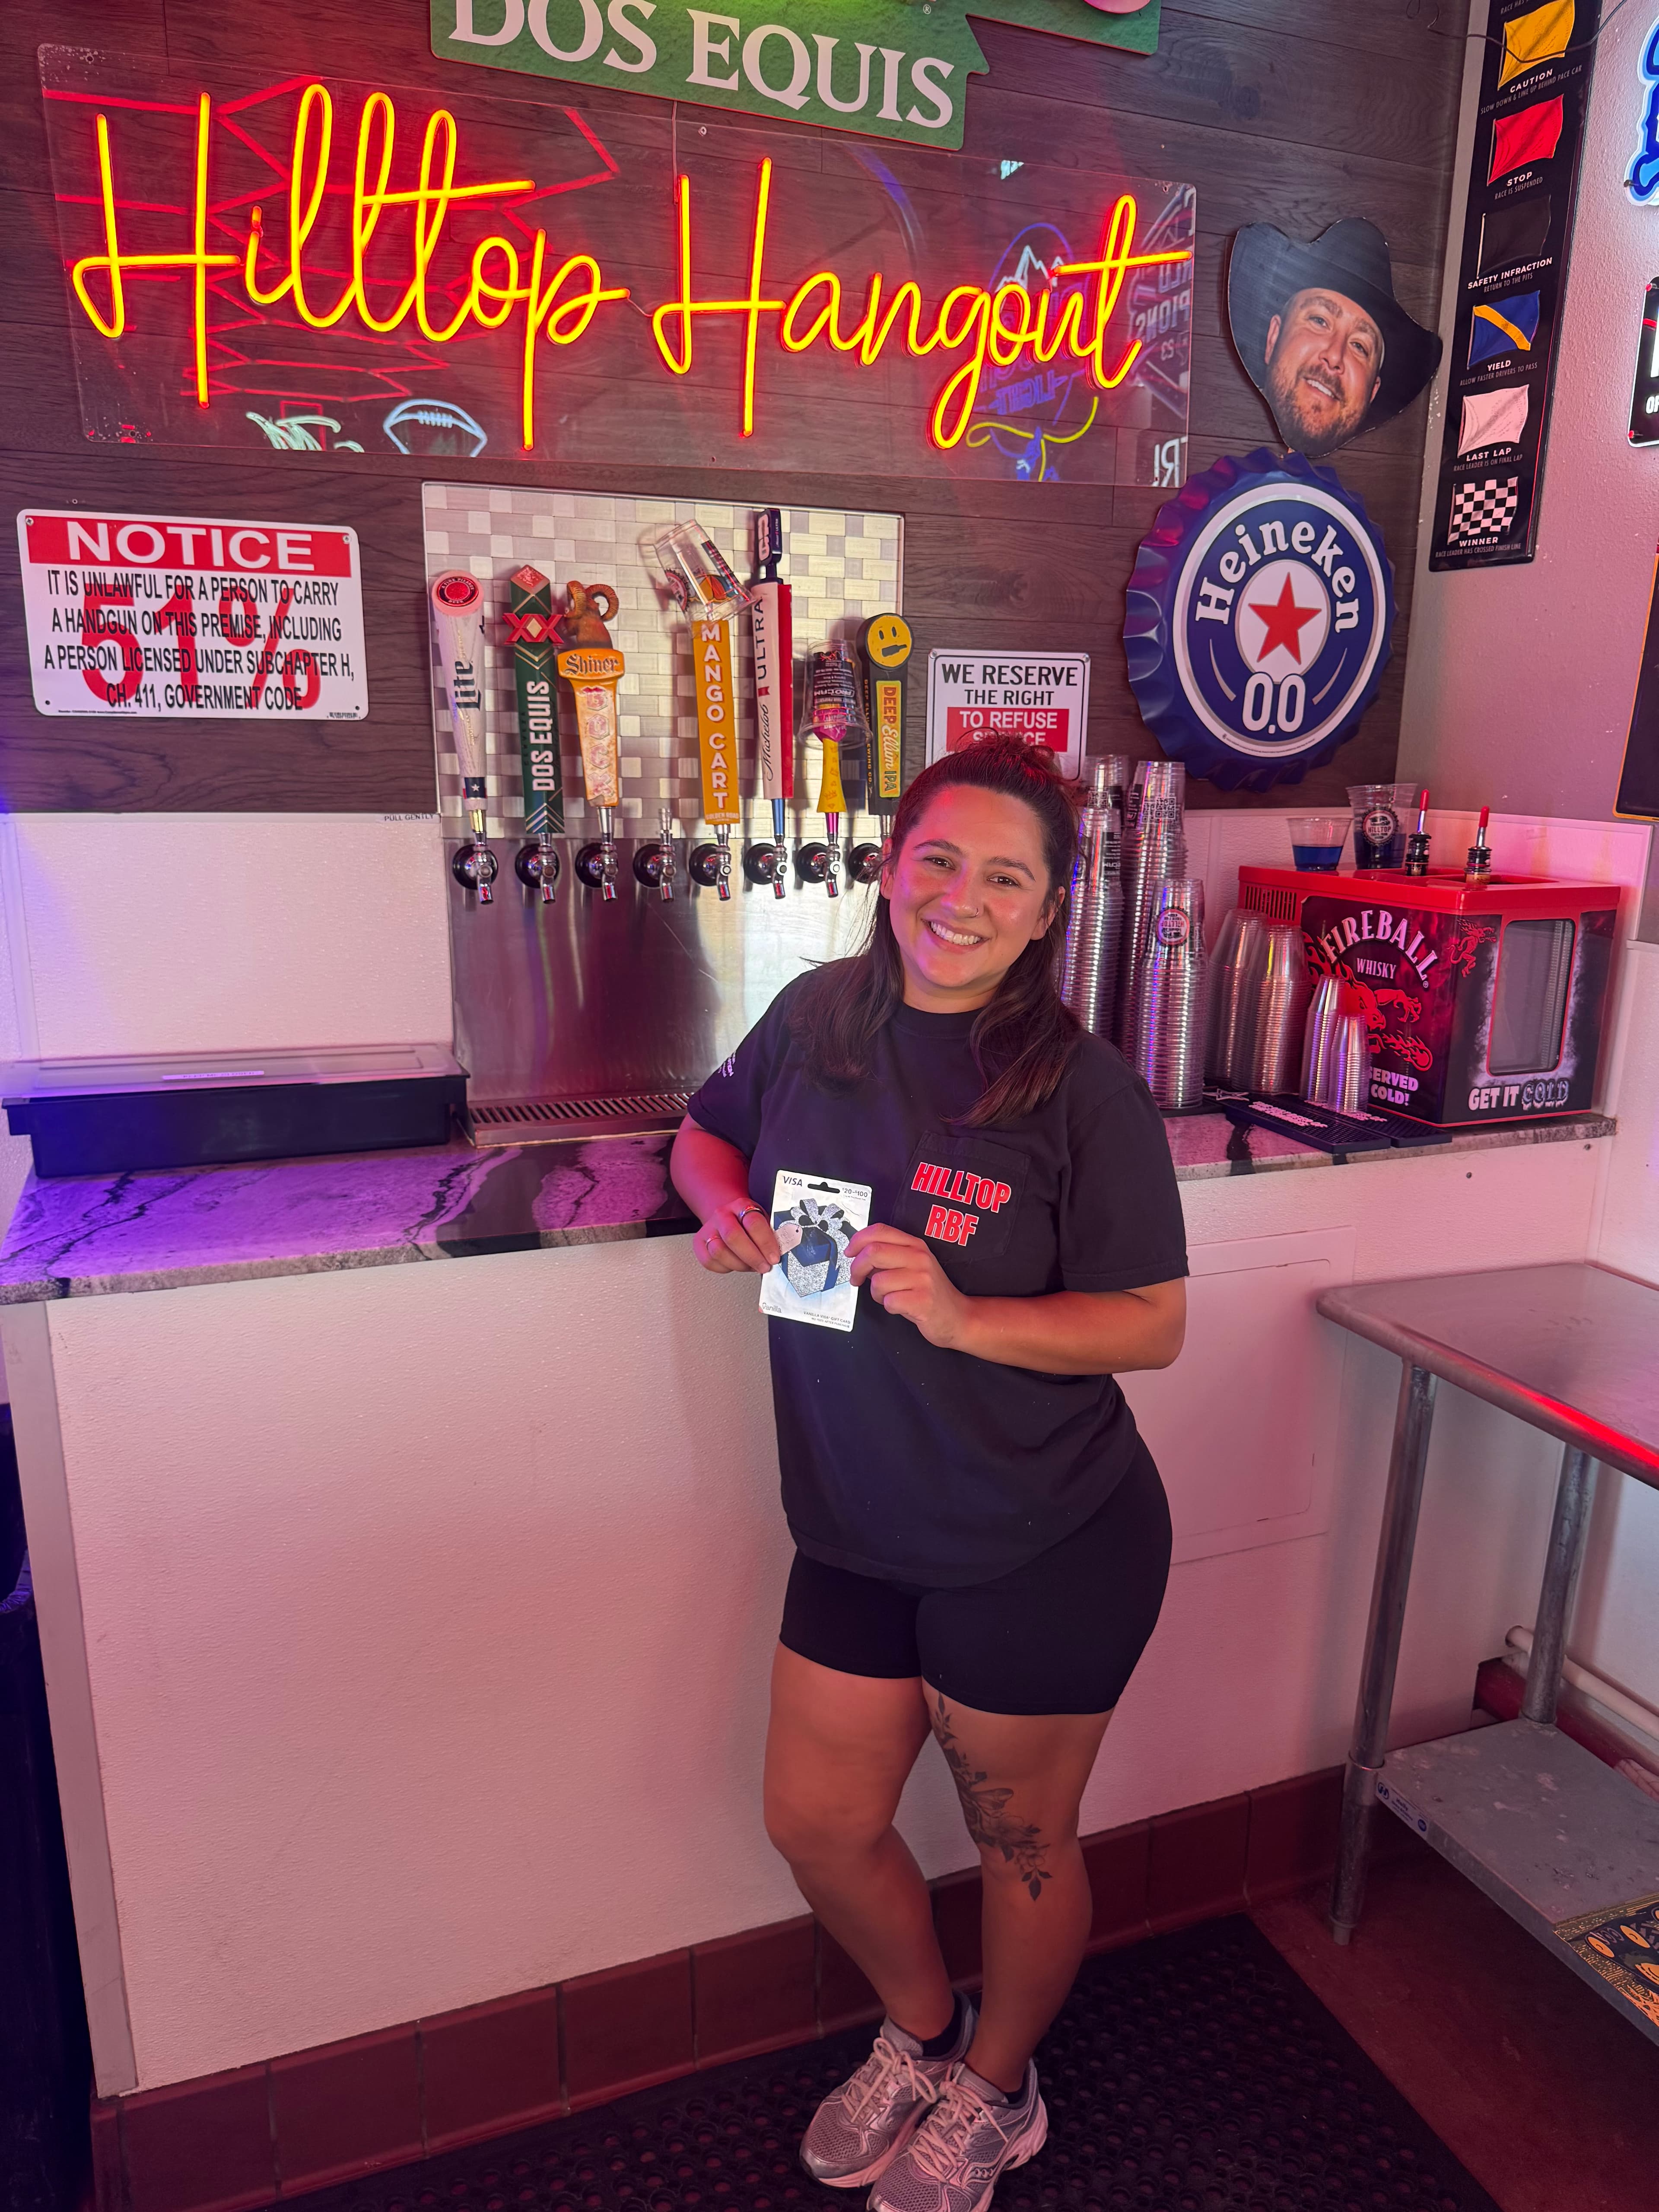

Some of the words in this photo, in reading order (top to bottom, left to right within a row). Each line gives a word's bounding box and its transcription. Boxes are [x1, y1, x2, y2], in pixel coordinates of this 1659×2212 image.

[448, 0, 657, 73] DOS
[685, 8, 954, 128] EQUIS
[1510, 68, 1553, 93] CAUTION
[1481, 103, 1494, 114] SLOW
[1496, 96, 1512, 108] DOWN
[1518, 90, 1529, 99] LINE
[1538, 77, 1556, 90] BEHIND
[1557, 71, 1570, 81] PACE
[1571, 65, 1582, 75] CAR
[1494, 189, 1506, 200] RACE
[1515, 177, 1543, 193] SUSPENDED
[1506, 172, 1532, 187] STOP
[72, 83, 630, 451] Hilltop
[652, 156, 1192, 448] Hangout
[1468, 274, 1498, 289] SAFETY
[1501, 257, 1552, 280] INFRACTION
[1484, 280, 1502, 293] RETURN
[1512, 276, 1521, 284] THE
[1522, 272, 1533, 282] PITS
[1459, 376, 1476, 386] ALLOW
[1477, 372, 1494, 383] FASTER
[1496, 367, 1516, 378] DRIVERS
[1525, 362, 1538, 371] PASS
[1487, 360, 1511, 372] YIELD
[1466, 451, 1489, 461] LAST
[1493, 448, 1512, 457] LAP
[1466, 461, 1484, 470] LEADER
[1499, 455, 1512, 464] FINAL
[66, 521, 315, 571] NOTICE
[1459, 537, 1498, 547] WINNER
[48, 570, 60, 595] IT
[65, 571, 79, 596] IS
[84, 572, 162, 600] UNLAWFUL
[166, 575, 194, 601] FOR
[198, 577, 209, 601] A
[211, 577, 267, 604] PERSON
[271, 579, 289, 604] TO
[293, 581, 339, 606] CARRY
[1195, 520, 1358, 633] Heineken
[52, 607, 63, 632] A
[66, 608, 137, 635] HANDGUN
[142, 611, 161, 636] ON
[169, 612, 197, 637] THIS
[202, 614, 266, 643] PREMISE,
[270, 616, 341, 641] INCLUDING
[503, 613, 564, 644] XX
[754, 598, 766, 680] ULTRA
[44, 645, 55, 669] A
[58, 646, 117, 671] PERSON
[122, 648, 191, 672] LICENSED
[195, 650, 244, 674] UNDER
[247, 651, 338, 677] SUBCHAPTER
[341, 654, 354, 680] H,
[80, 583, 321, 710] 51%
[565, 653, 618, 675] Shiner
[701, 623, 721, 722] MANGO
[942, 664, 975, 684] WE
[982, 665, 1077, 686] RESERVE
[106, 683, 131, 708] CH.
[134, 684, 161, 712] 411,
[164, 685, 261, 710] GOVERNMENT
[265, 686, 303, 710] CODE
[454, 661, 481, 711] Lite
[964, 690, 998, 705] THE
[1003, 690, 1055, 706] RIGHT
[527, 680, 553, 745] EQUIS
[883, 686, 896, 724] DEEP
[1242, 672, 1306, 734] 0.0
[960, 711, 984, 728] TO
[990, 712, 1058, 729] REFUSE
[758, 704, 773, 781] Michelob
[881, 724, 900, 769] Ellum
[531, 750, 555, 791] DOS
[709, 733, 728, 809] CART
[884, 770, 896, 791] IPA
[1321, 909, 1439, 982] FIREBALL
[1357, 957, 1396, 980] WHISKY
[1371, 1083, 1410, 1106] COLD!
[1468, 1086, 1500, 1111] GET
[1502, 1085, 1519, 1107] IT
[1521, 1080, 1569, 1109] COLD
[782, 1176, 802, 1187] VISA
[911, 1162, 1012, 1213] HILLTOP
[925, 1204, 979, 1246] RBF
[762, 1302, 782, 1313] Vanilla
